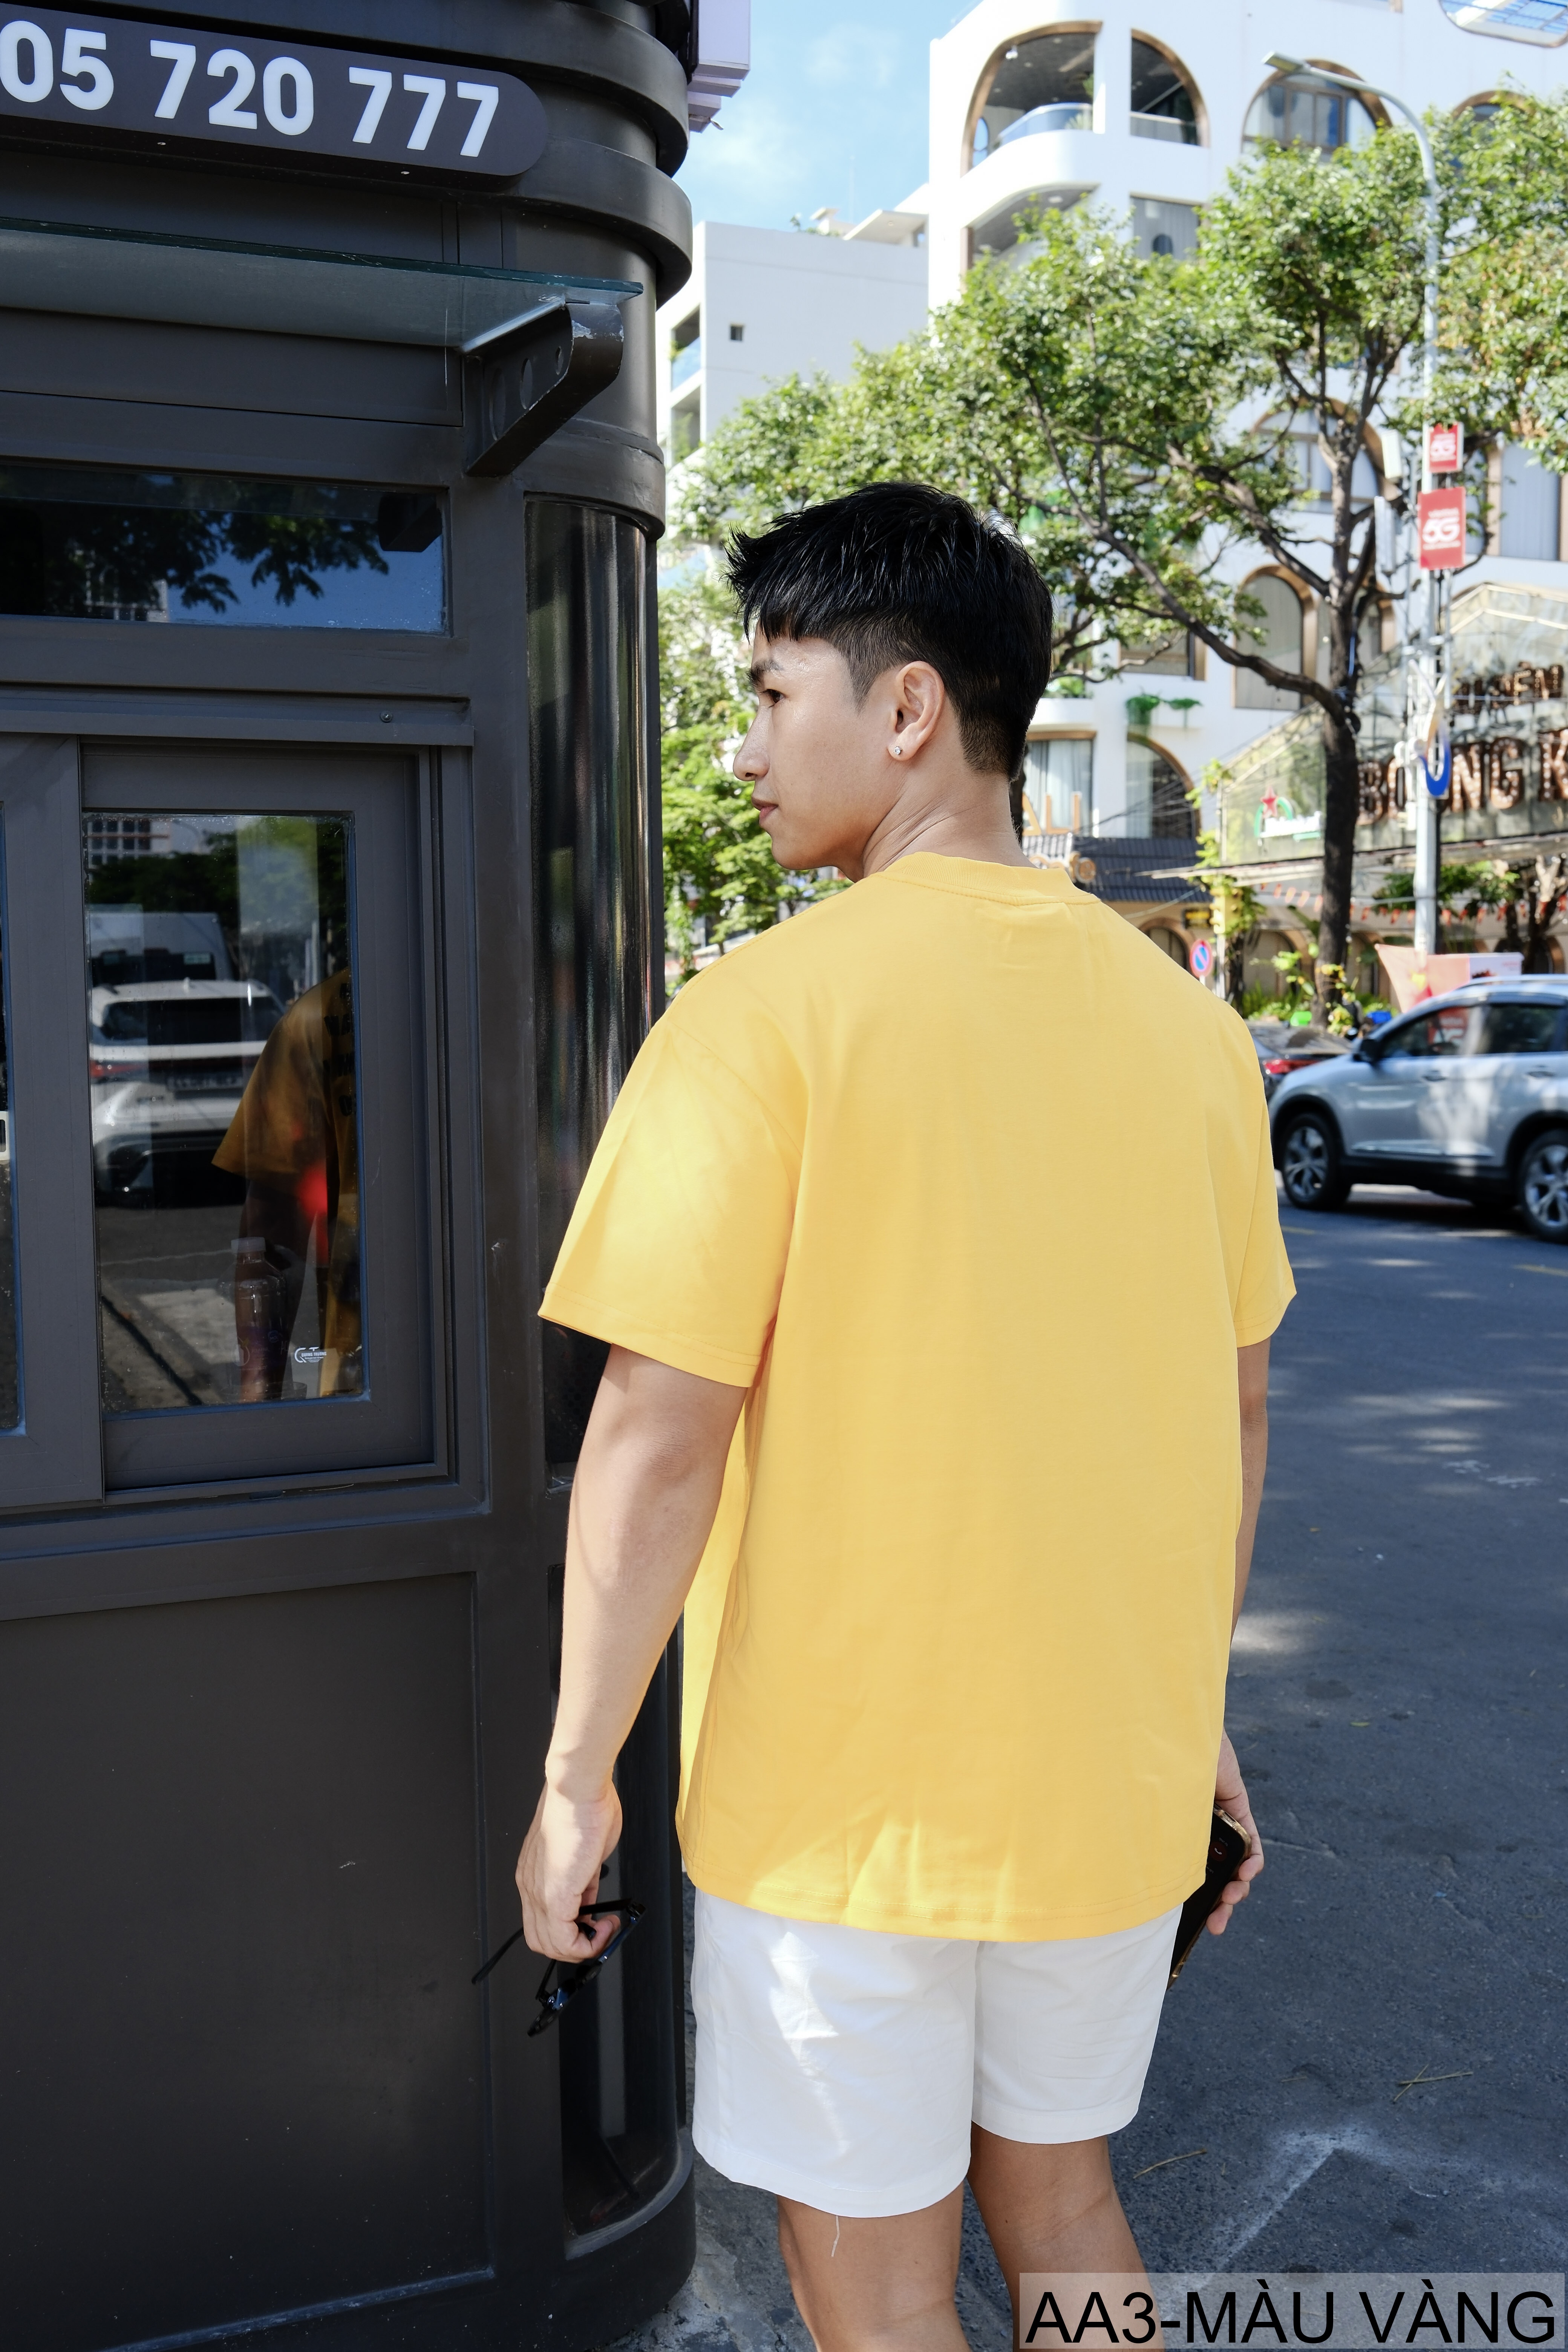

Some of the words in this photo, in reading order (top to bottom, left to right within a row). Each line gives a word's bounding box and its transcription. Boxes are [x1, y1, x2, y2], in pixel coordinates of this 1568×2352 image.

[0, 20, 114, 110] 05
[150, 40, 314, 136] 720
[349, 67, 499, 158] 777
